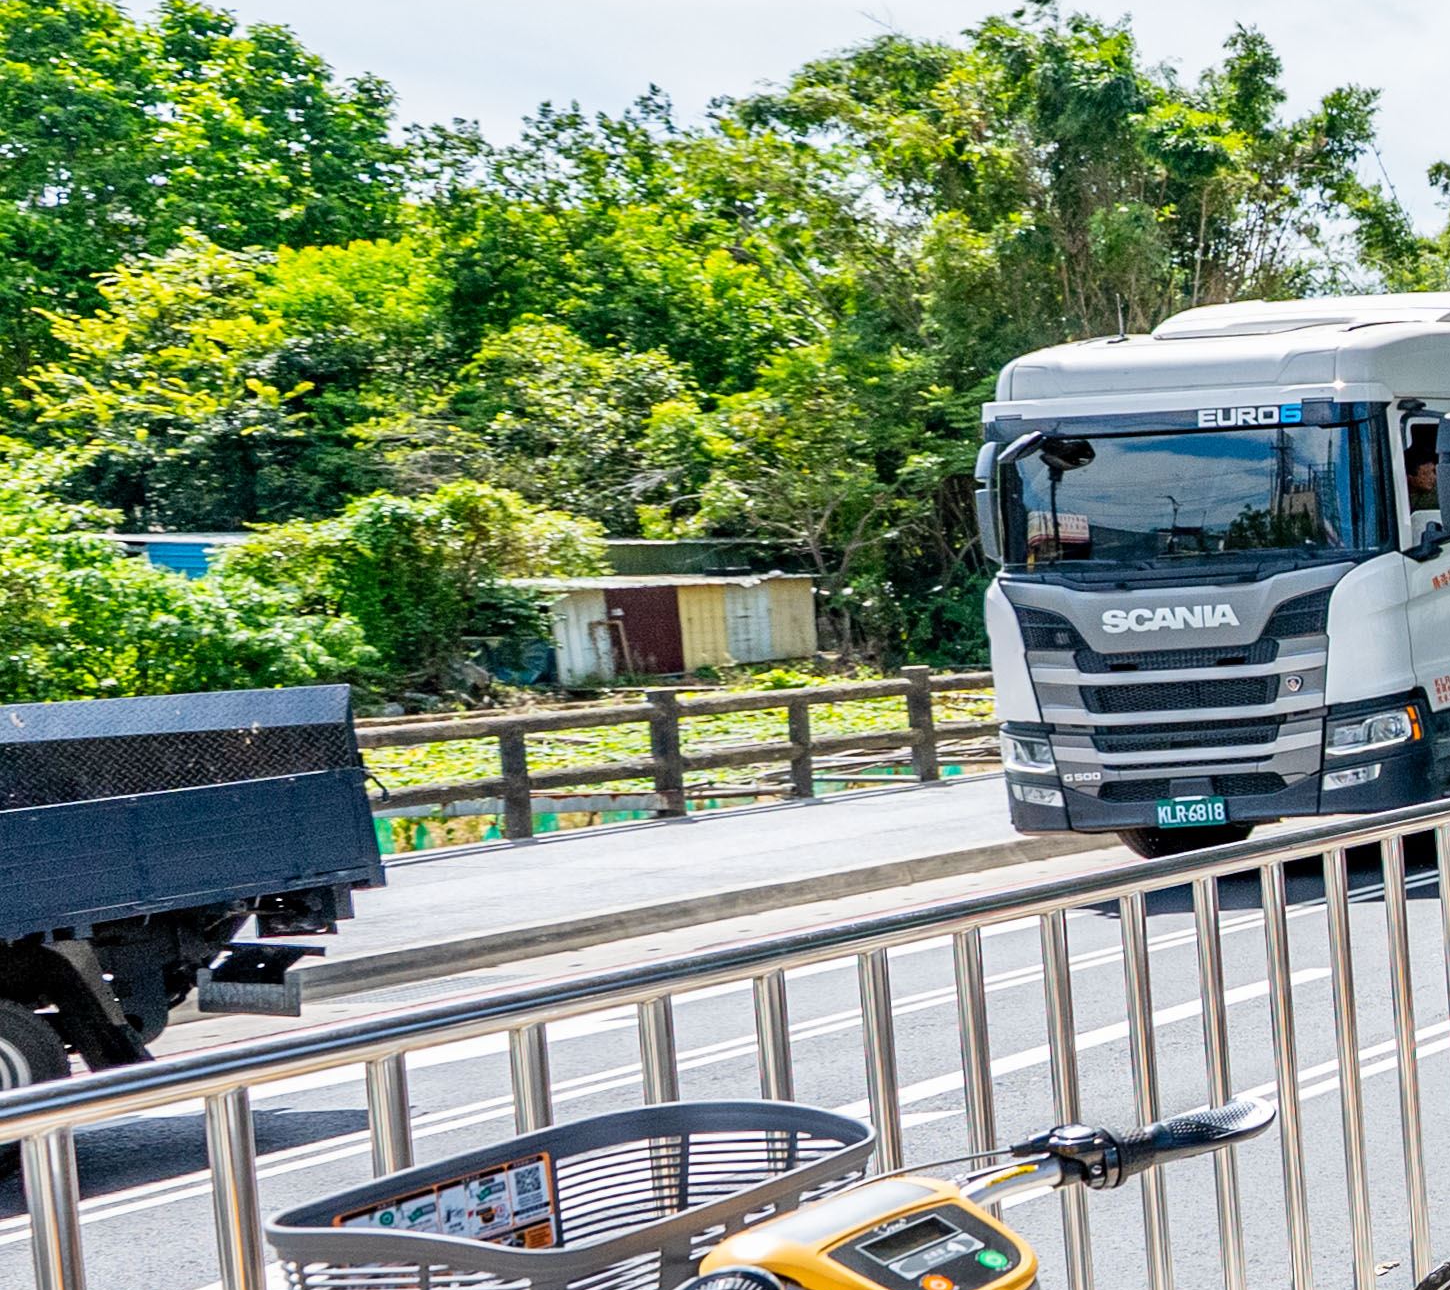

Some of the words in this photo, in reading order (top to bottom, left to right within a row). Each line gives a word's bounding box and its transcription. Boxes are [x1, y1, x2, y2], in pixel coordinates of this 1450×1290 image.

[1198, 403, 1303, 428] EURO6
[1102, 603, 1240, 634] SCANIA
[1158, 802, 1225, 826] KLR-6818
